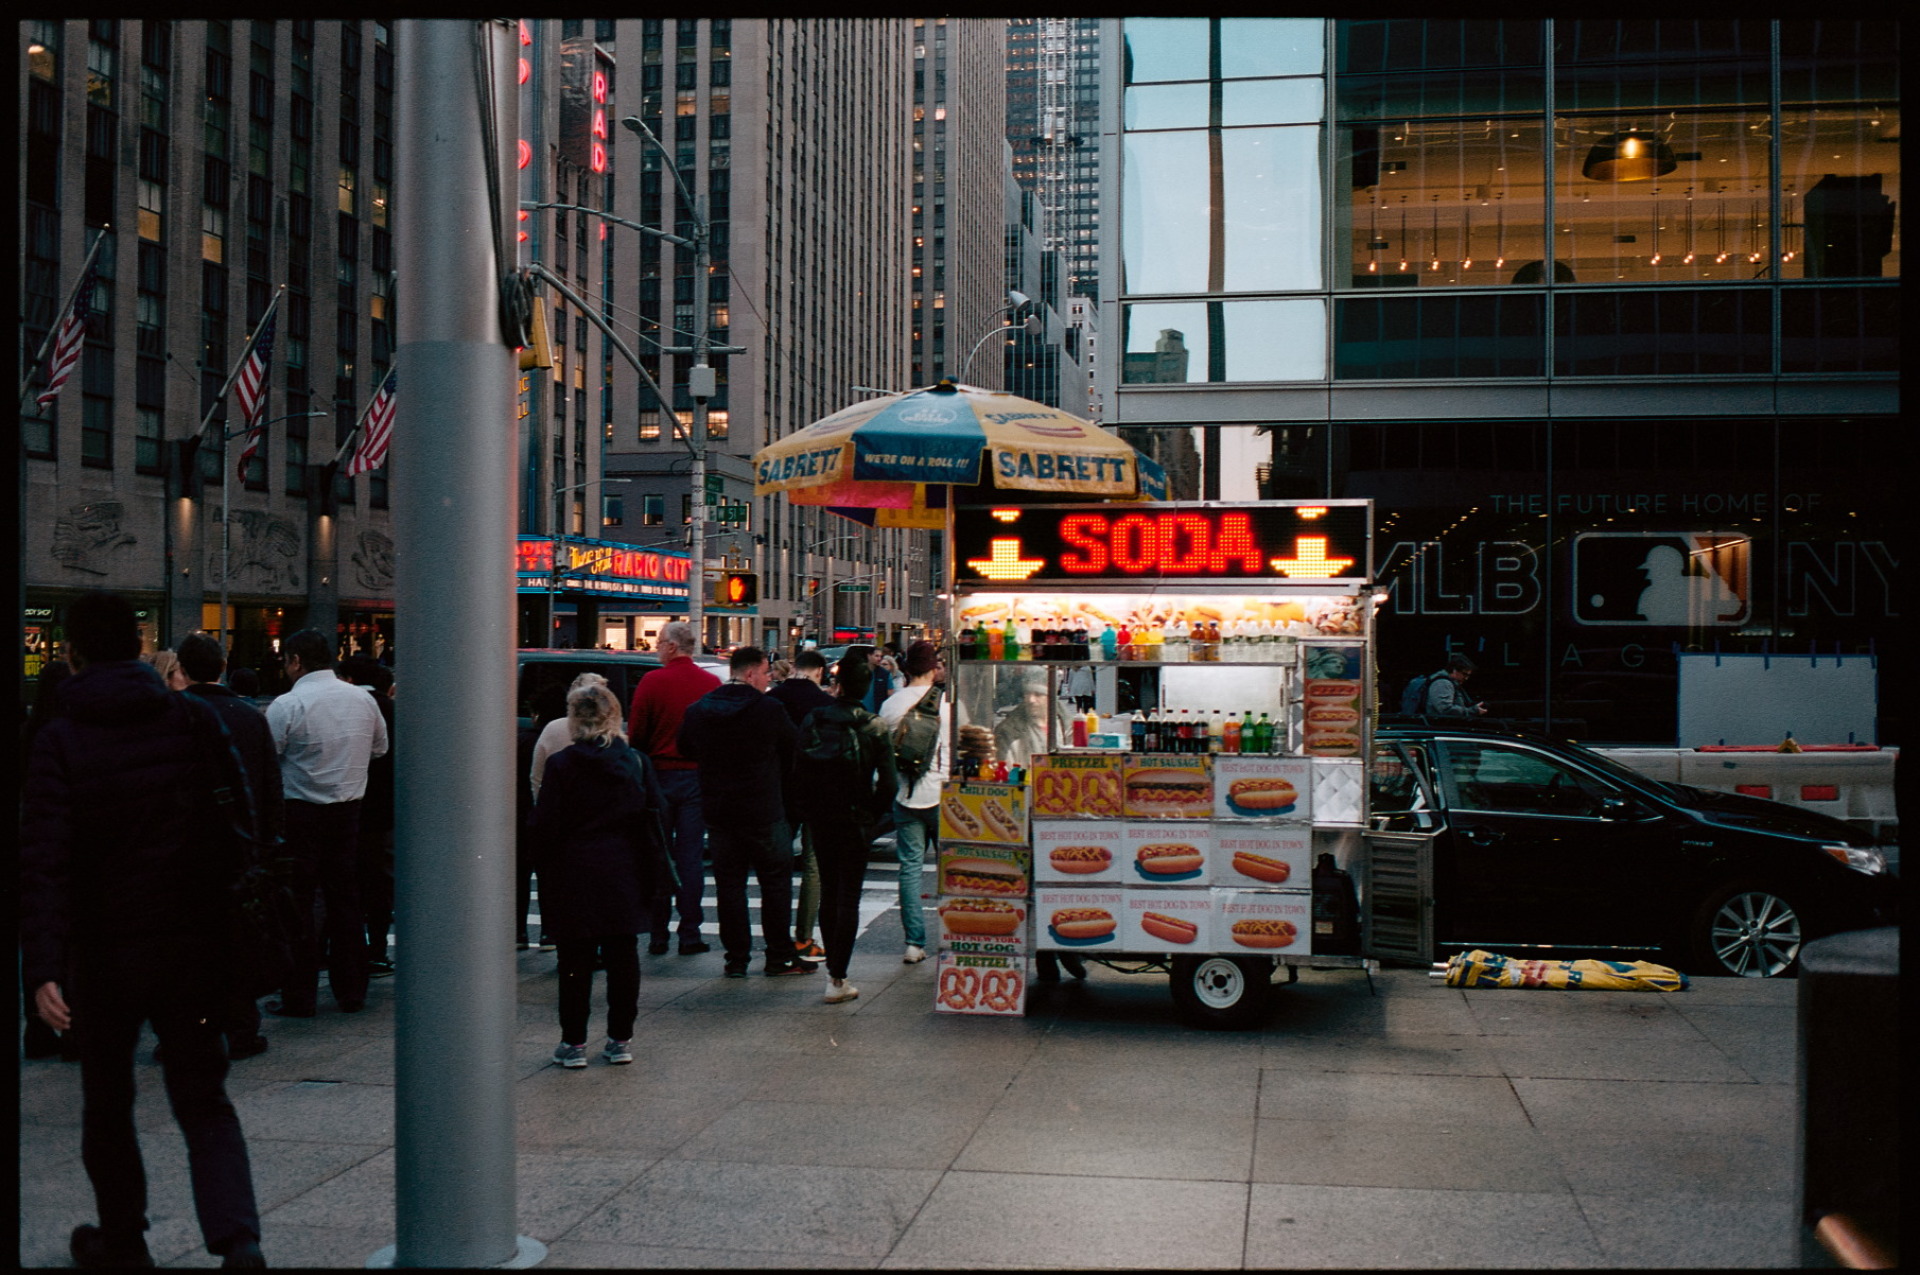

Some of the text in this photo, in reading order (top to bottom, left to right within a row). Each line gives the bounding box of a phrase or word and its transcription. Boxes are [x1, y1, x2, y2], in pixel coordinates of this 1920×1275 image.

[984, 412, 1059, 425] SABRETT
[759, 447, 842, 486] SABRETT
[864, 453, 897, 466] WE'RE
[900, 455, 916, 465] ON
[917, 456, 925, 466] A
[927, 456, 953, 468] ROLL
[999, 451, 1126, 483] SABRETT
[1488, 492, 1823, 514] THE FUTURE HOME OF
[1061, 514, 1261, 572] SODA
[612, 551, 659, 578] RADIO
[1051, 757, 1109, 769] PRETZEL
[1140, 757, 1200, 768] HOT SAUSAGE
[1239, 764, 1255, 774] HOT
[1256, 764, 1272, 774] DOG
[1283, 764, 1305, 774] TOWN
[959, 786, 1008, 797] CHILI DOG
[1058, 831, 1073, 841] HOT
[1074, 831, 1089, 841] DOG
[1099, 831, 1120, 841] TOWN
[1146, 829, 1161, 839] HOT
[1162, 829, 1178, 839] DOG
[1188, 829, 1210, 839] TOWN
[1239, 839, 1254, 849] HOT
[1255, 839, 1271, 849] DOG
[1282, 839, 1304, 849] TOWN
[956, 847, 1013, 860] HOT SAUSAGE
[1060, 894, 1074, 904] HOT
[1075, 894, 1090, 904] DOG
[1101, 894, 1122, 904] TOWN
[1147, 899, 1162, 909] HOT
[1163, 899, 1178, 909] DOG
[1190, 899, 1211, 909] TOWN
[943, 933, 967, 941] BEST
[994, 936, 1022, 944] YORK
[951, 941, 1015, 953] HOT GOG
[956, 956, 1010, 968] PRETZEL
